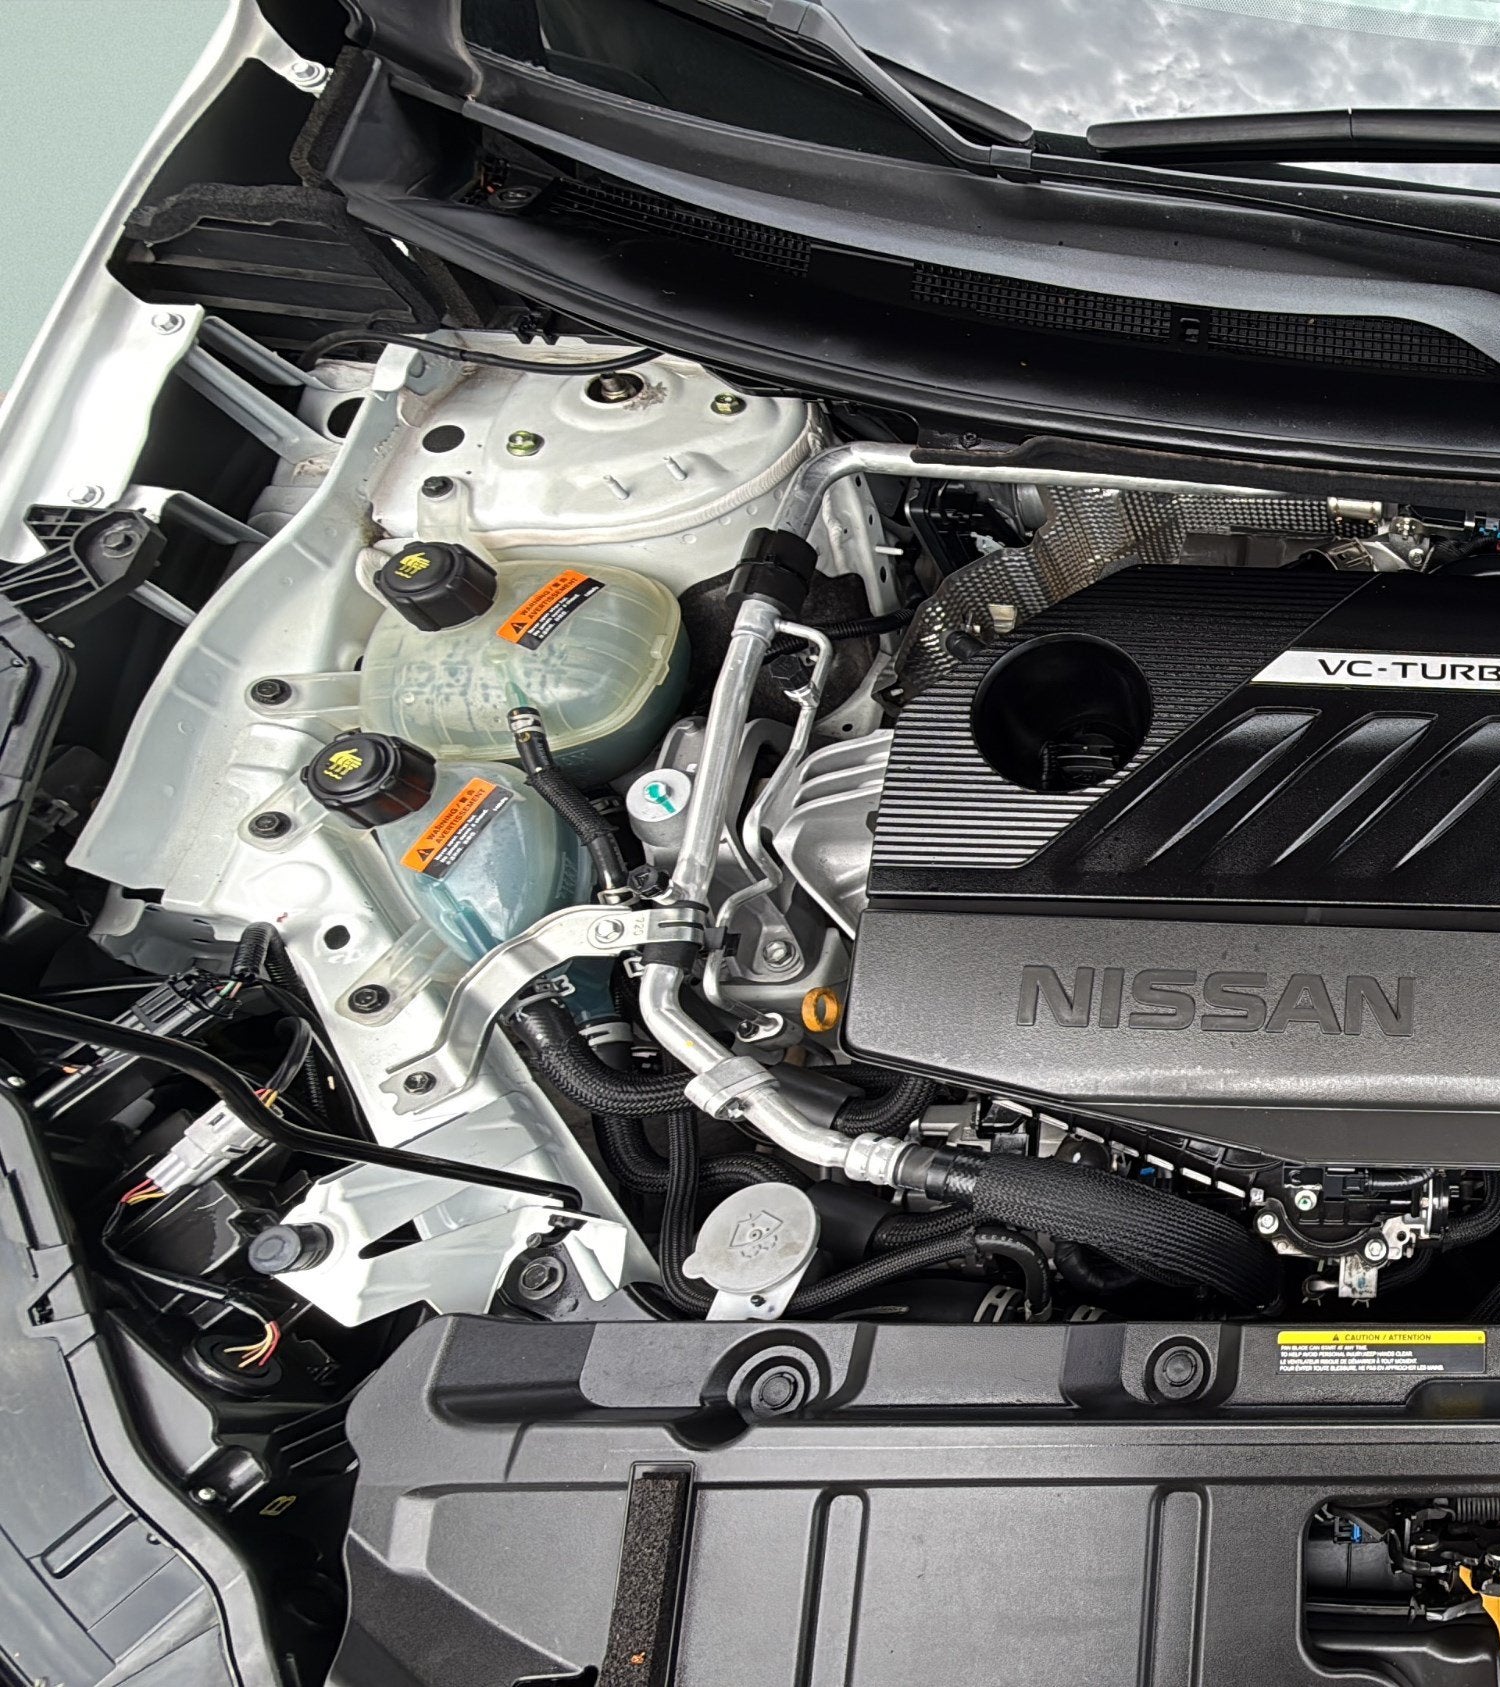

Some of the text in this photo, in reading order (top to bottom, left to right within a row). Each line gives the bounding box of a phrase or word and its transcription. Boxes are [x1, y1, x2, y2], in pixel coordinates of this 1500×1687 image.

[521, 590, 552, 616] WARNING
[528, 577, 579, 620] AVERTISSEMENT
[426, 808, 458, 841] WARNING
[435, 788, 486, 844] AVERTISSEMENT
[1016, 965, 1416, 1037] NISSAN
